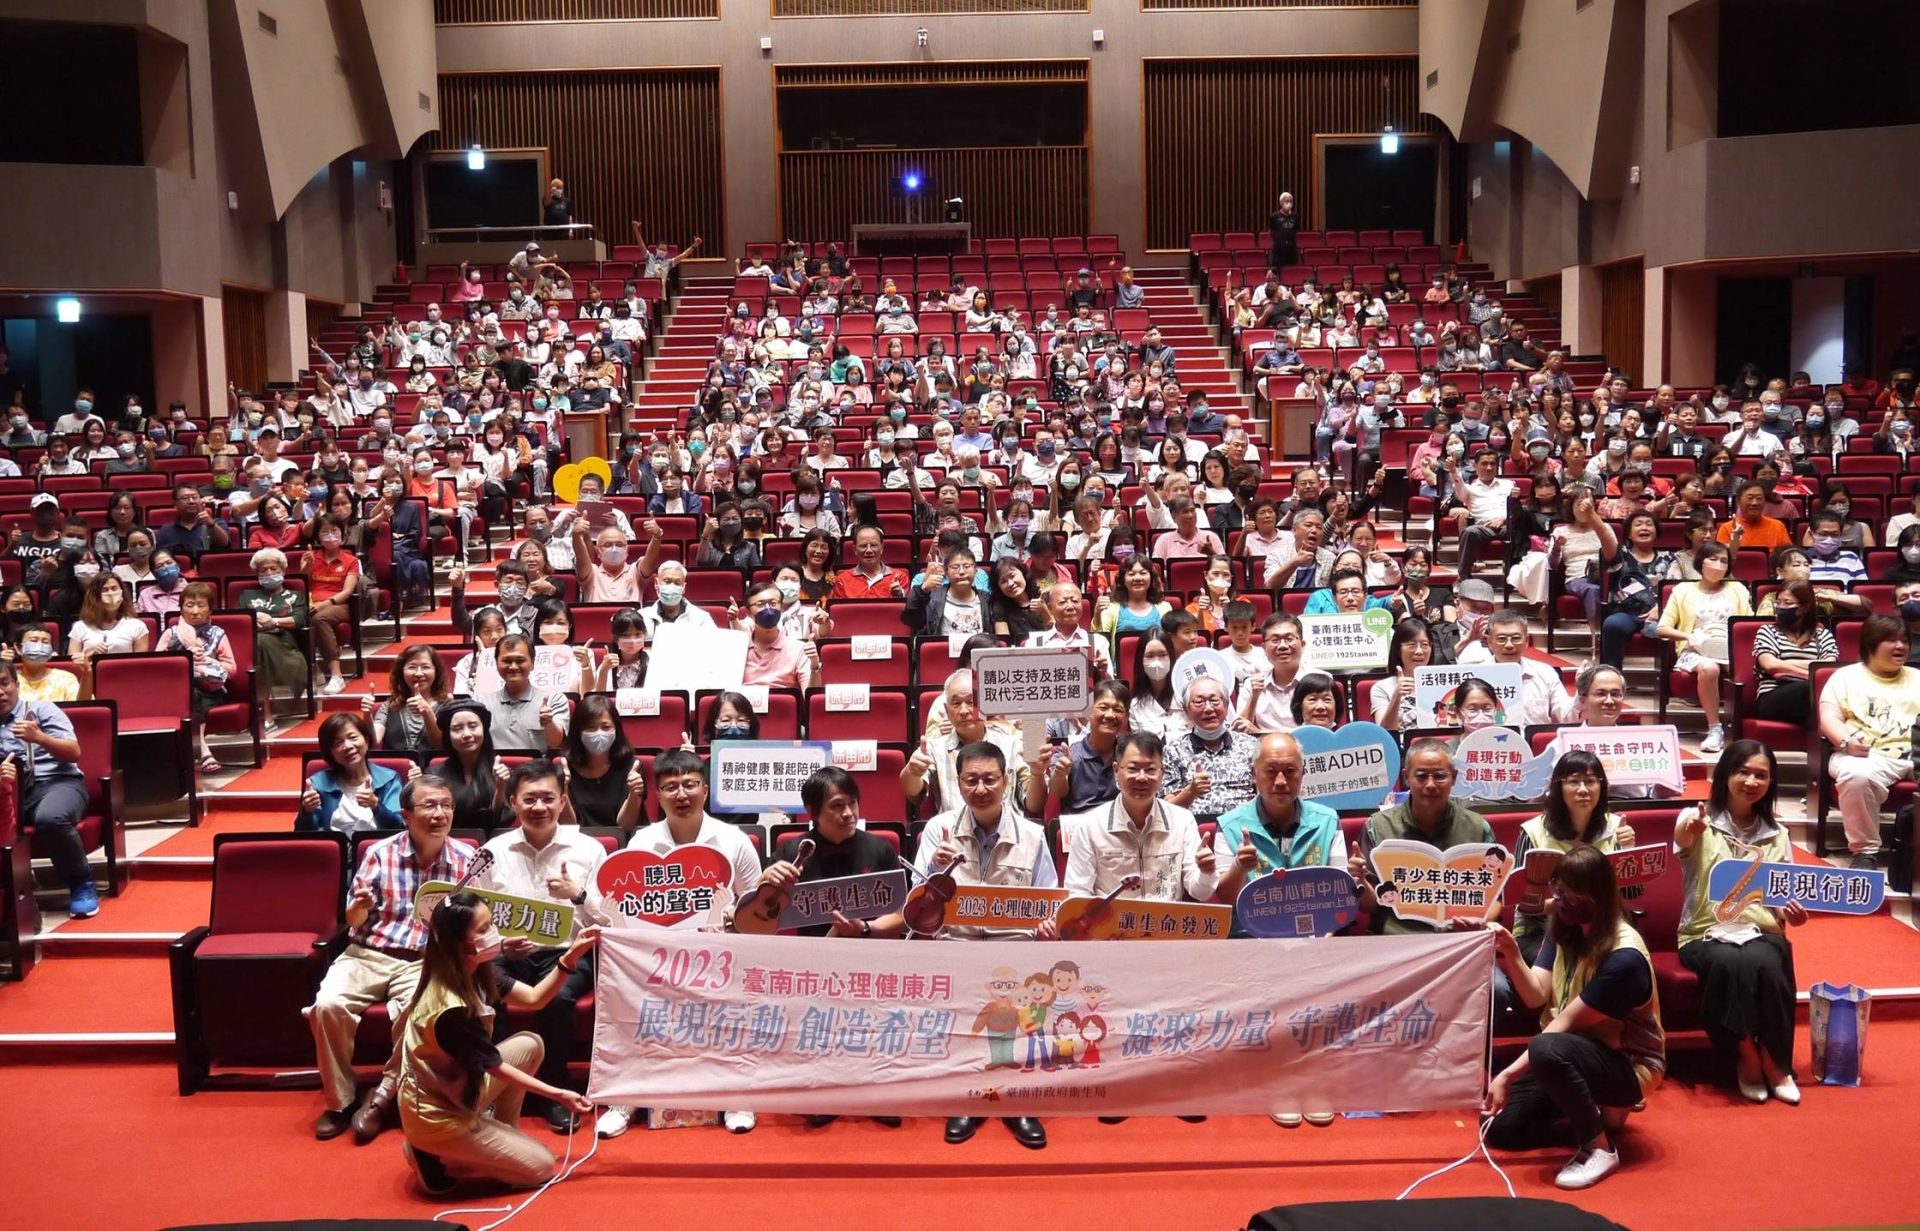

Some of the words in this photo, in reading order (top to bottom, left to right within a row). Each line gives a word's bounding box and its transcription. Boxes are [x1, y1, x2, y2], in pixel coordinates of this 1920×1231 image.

[1312, 623, 1363, 635] 臺南市社區
[1367, 616, 1387, 626] LINE
[1312, 634, 1374, 647] 心理衛生中心
[984, 666, 1081, 685] 請以支持及接納
[984, 684, 1081, 702] 取代污名及拒絕
[722, 762, 770, 776] 精神健康
[773, 762, 821, 776] 醫起陪伴
[1303, 748, 1383, 775] 識ADHD
[1466, 749, 1523, 767] 展現行動
[722, 778, 770, 792] 家庭支持
[1302, 775, 1380, 796] 找到孩子的獨特
[1465, 768, 1524, 784] 創造希望
[643, 863, 685, 886] 聽見
[1615, 849, 1666, 879] 希望
[1392, 868, 1493, 886] 青少年的未來
[1766, 869, 1873, 905] 展現行動
[618, 887, 714, 917] 心的聲音
[791, 879, 894, 918] 守護生命
[1252, 879, 1349, 905] 台南心衛中心
[1400, 887, 1484, 906] 你我共關懷
[957, 896, 986, 916] 2023
[492, 899, 561, 938] 聚力量
[1118, 911, 1220, 936] 讓生命發光
[646, 947, 733, 990] 2023
[742, 966, 954, 1001] 臺南市心理健康月
[634, 998, 789, 1052] 展現行動
[795, 1006, 956, 1058] 創造希望
[1121, 1007, 1273, 1058] 凝聚力量
[1285, 998, 1438, 1049] 守護生命
